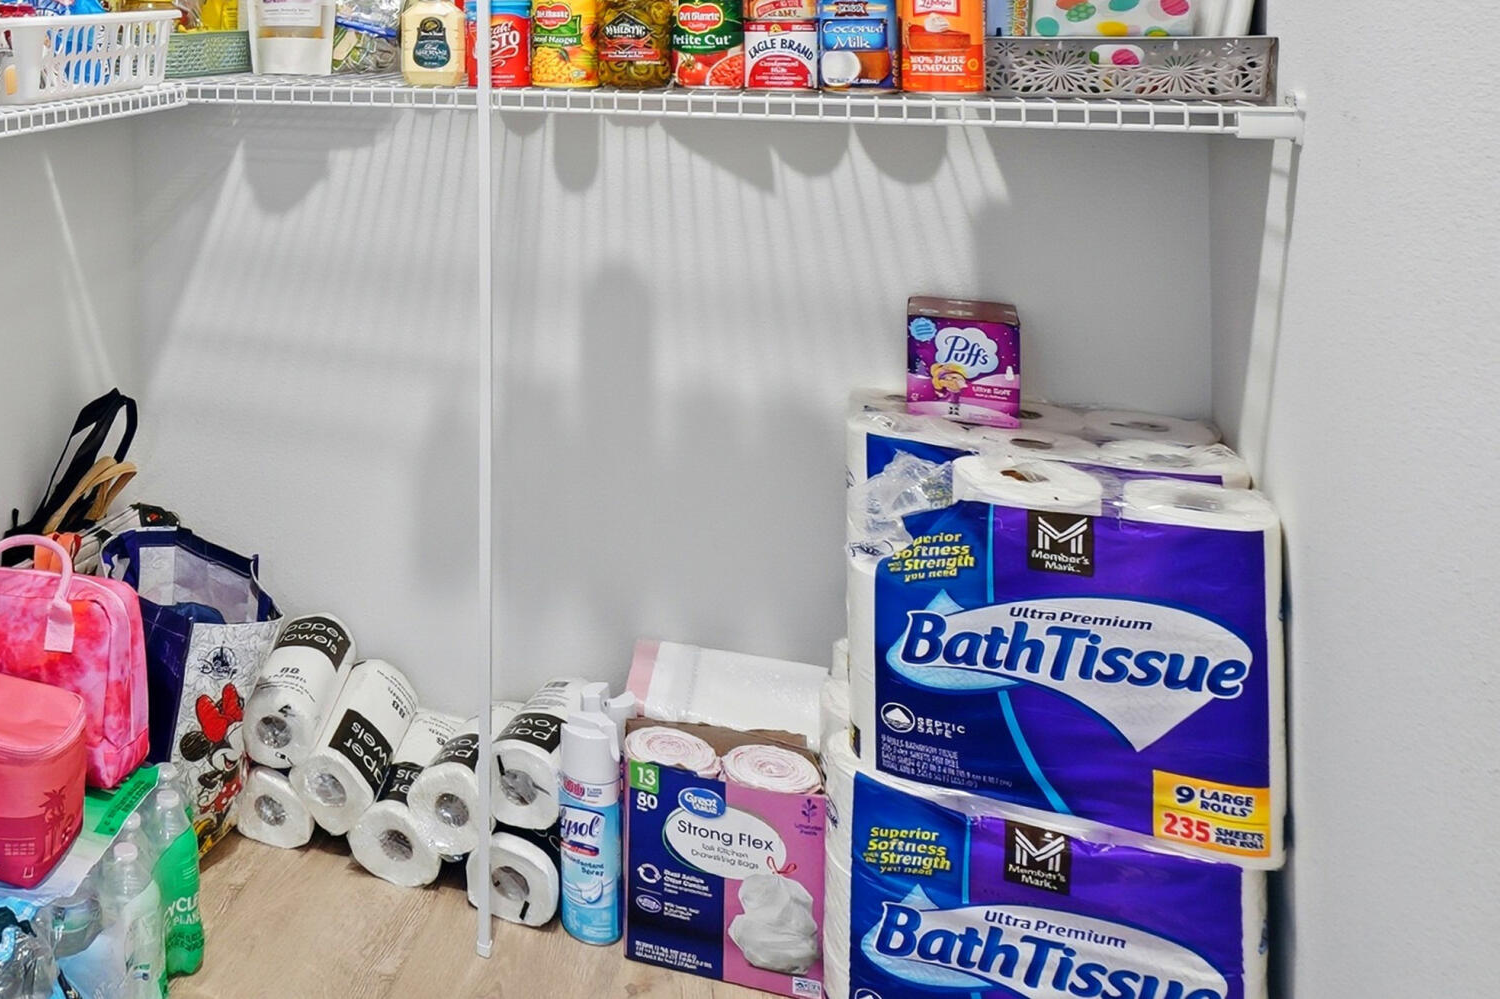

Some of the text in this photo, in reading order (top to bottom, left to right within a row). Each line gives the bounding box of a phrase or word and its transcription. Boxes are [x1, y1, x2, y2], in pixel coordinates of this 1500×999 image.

[823, 20, 885, 33] Coconut
[748, 38, 815, 61] EAGLE BRAND
[833, 35, 871, 49] Milk
[911, 63, 964, 73] PUMPKIN
[933, 55, 966, 64] PURE
[944, 335, 989, 368] Puffs
[913, 533, 963, 547] perior
[891, 545, 971, 560] Softness
[1031, 548, 1091, 567] Member's
[903, 555, 975, 571] Strength
[904, 568, 958, 583] you need
[1009, 606, 1153, 631] Ultra Premium
[285, 622, 345, 643] paper
[280, 632, 338, 655] towels
[916, 717, 967, 734] SEPTIC
[916, 725, 953, 738] SAFE
[343, 738, 384, 785] aper
[636, 766, 656, 786] 13
[1175, 785, 1254, 807] 9 LARGE
[1200, 800, 1250, 818] ROLLS
[677, 820, 774, 851] Strong Flex
[870, 826, 940, 841] Superior
[1163, 812, 1265, 843] 235 SHEETS
[868, 839, 948, 857] Softness
[1215, 837, 1238, 847] PER
[880, 851, 952, 871] Strength
[1008, 863, 1066, 883] Member's
[983, 908, 1128, 950] Ultra Premium
